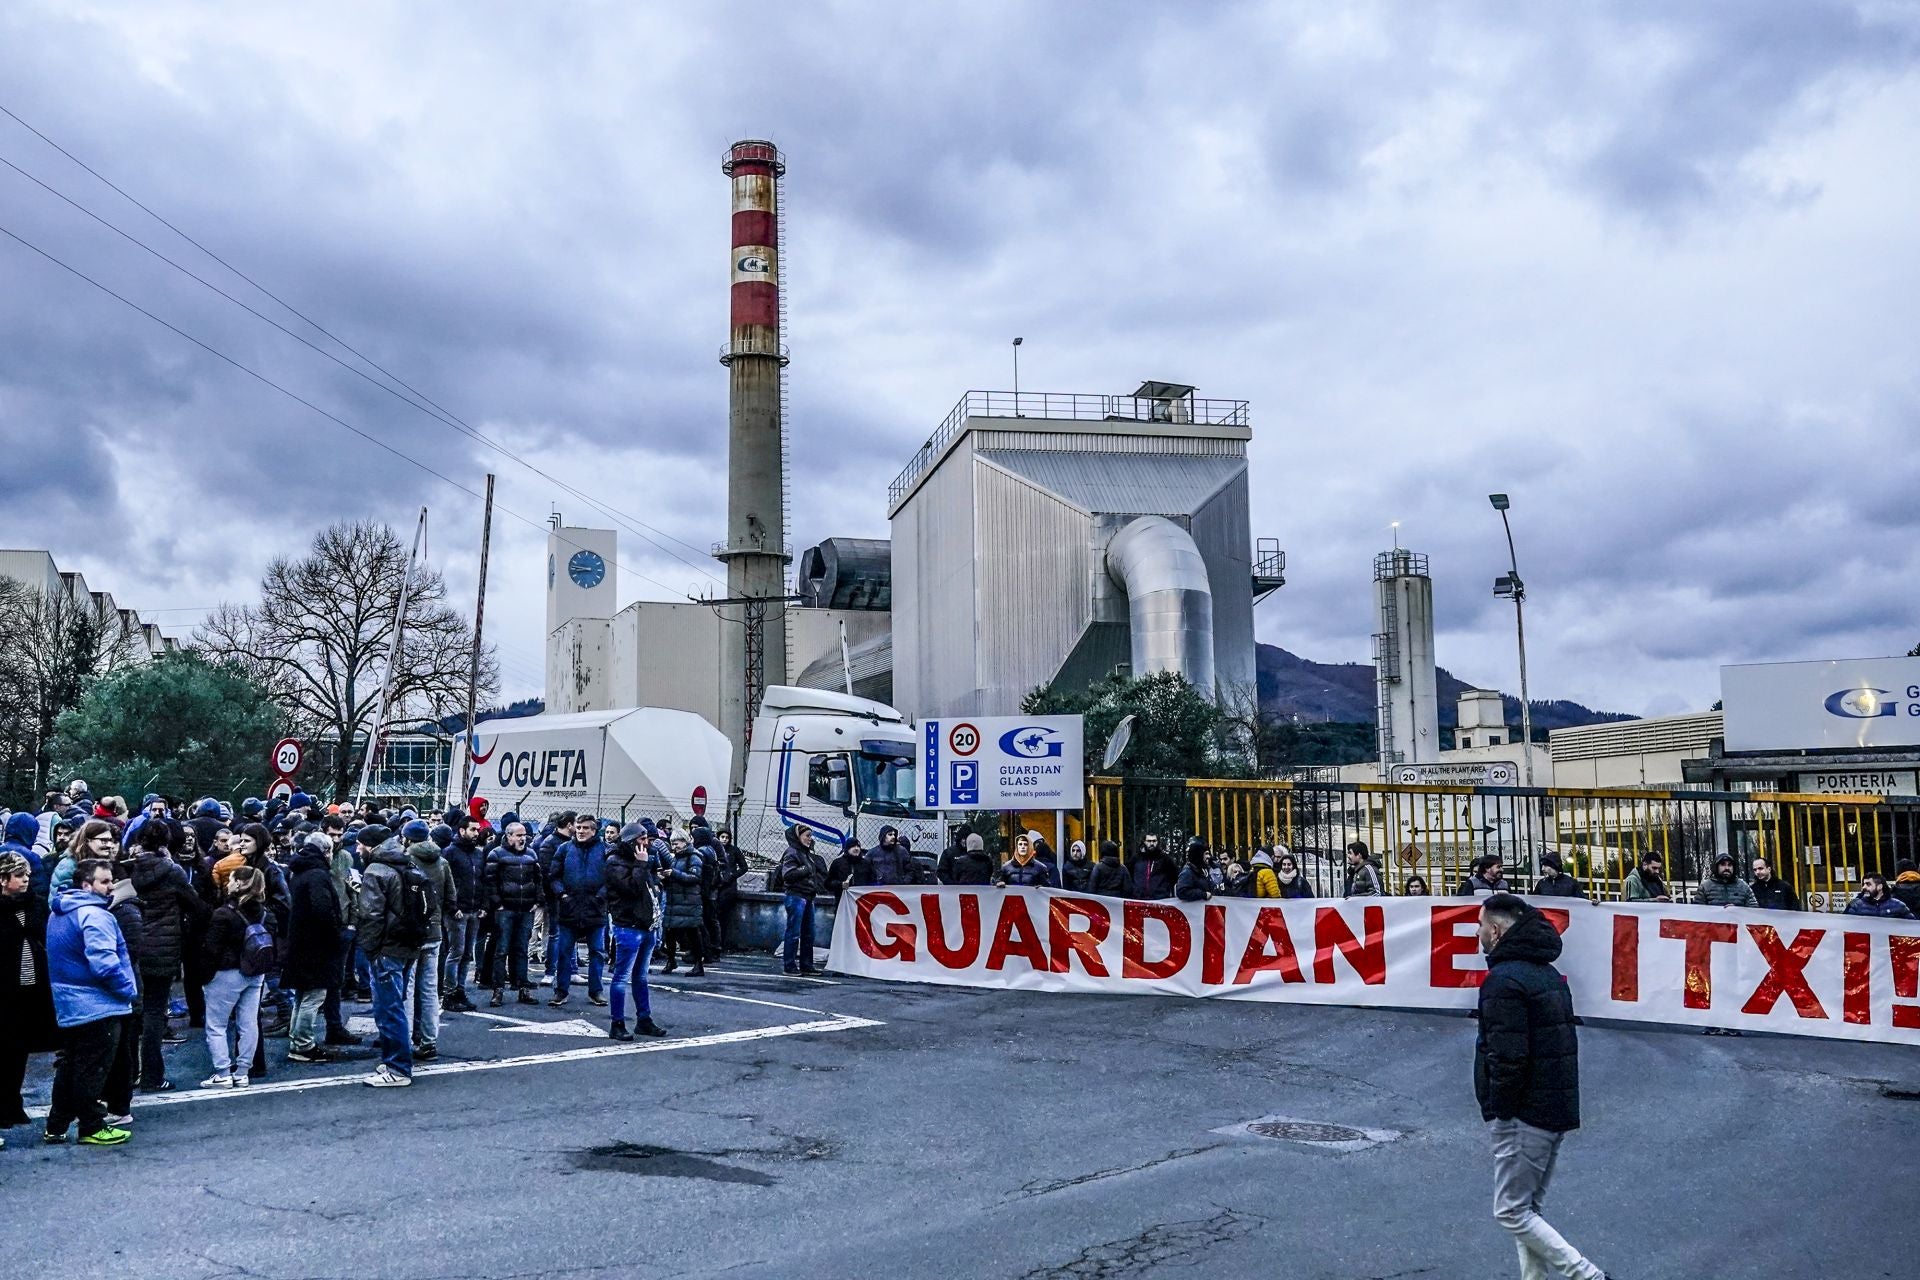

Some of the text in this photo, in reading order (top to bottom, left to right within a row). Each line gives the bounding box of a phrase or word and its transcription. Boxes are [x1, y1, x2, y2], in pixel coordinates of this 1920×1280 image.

[1906, 685, 1920, 699] G
[955, 733, 975, 746] 20
[280, 751, 297, 765] 20
[928, 724, 937, 803] VISITAS
[498, 749, 587, 788] OGUETA
[1000, 765, 1061, 775] GUARDIAN
[1470, 765, 1487, 773] AREA
[1493, 770, 1507, 779] 20
[956, 765, 973, 788] P
[1000, 777, 1038, 786] GLASS
[1402, 773, 1416, 781] 20
[1034, 790, 1061, 798] possible
[855, 892, 1387, 986] GUARDIAN
